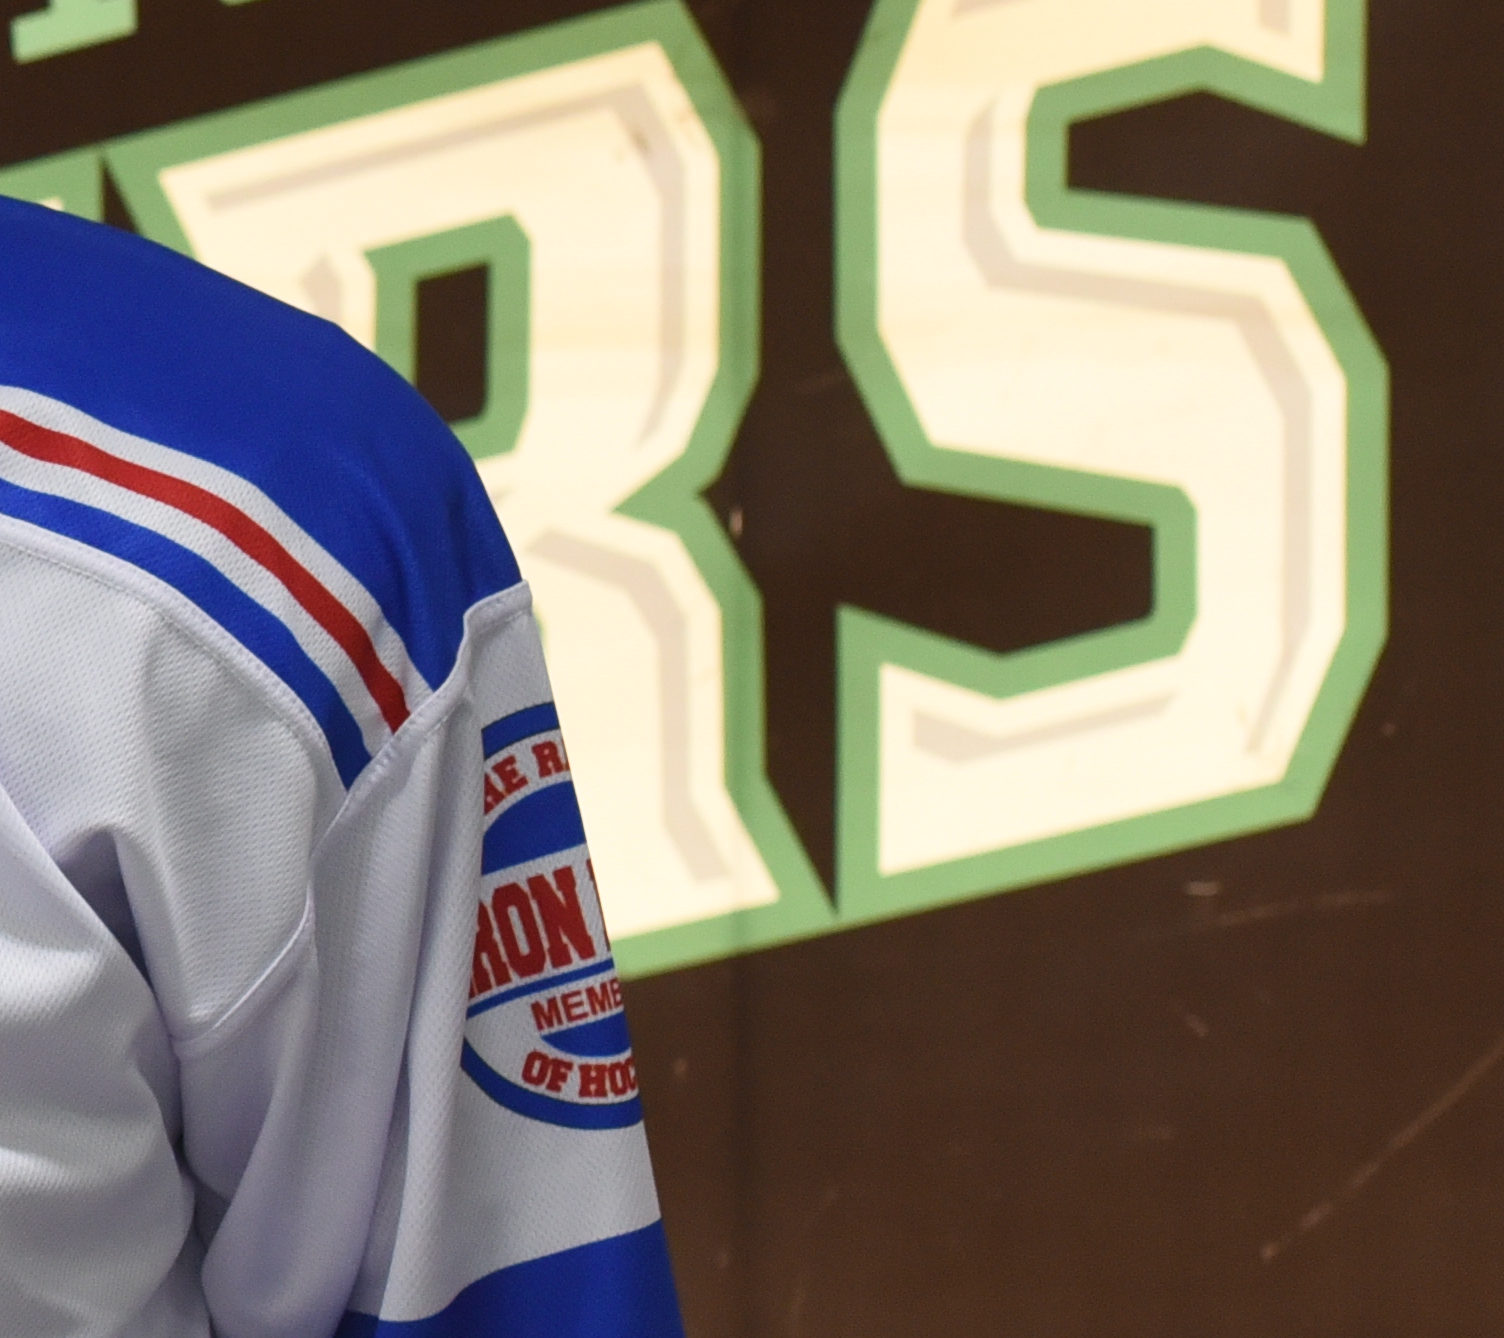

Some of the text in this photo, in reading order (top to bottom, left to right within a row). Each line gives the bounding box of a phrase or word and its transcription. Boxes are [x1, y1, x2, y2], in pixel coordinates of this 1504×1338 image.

[469, 866, 595, 999] RON
[530, 981, 623, 1032] MEMB
[520, 1050, 640, 1100] OF HOC
